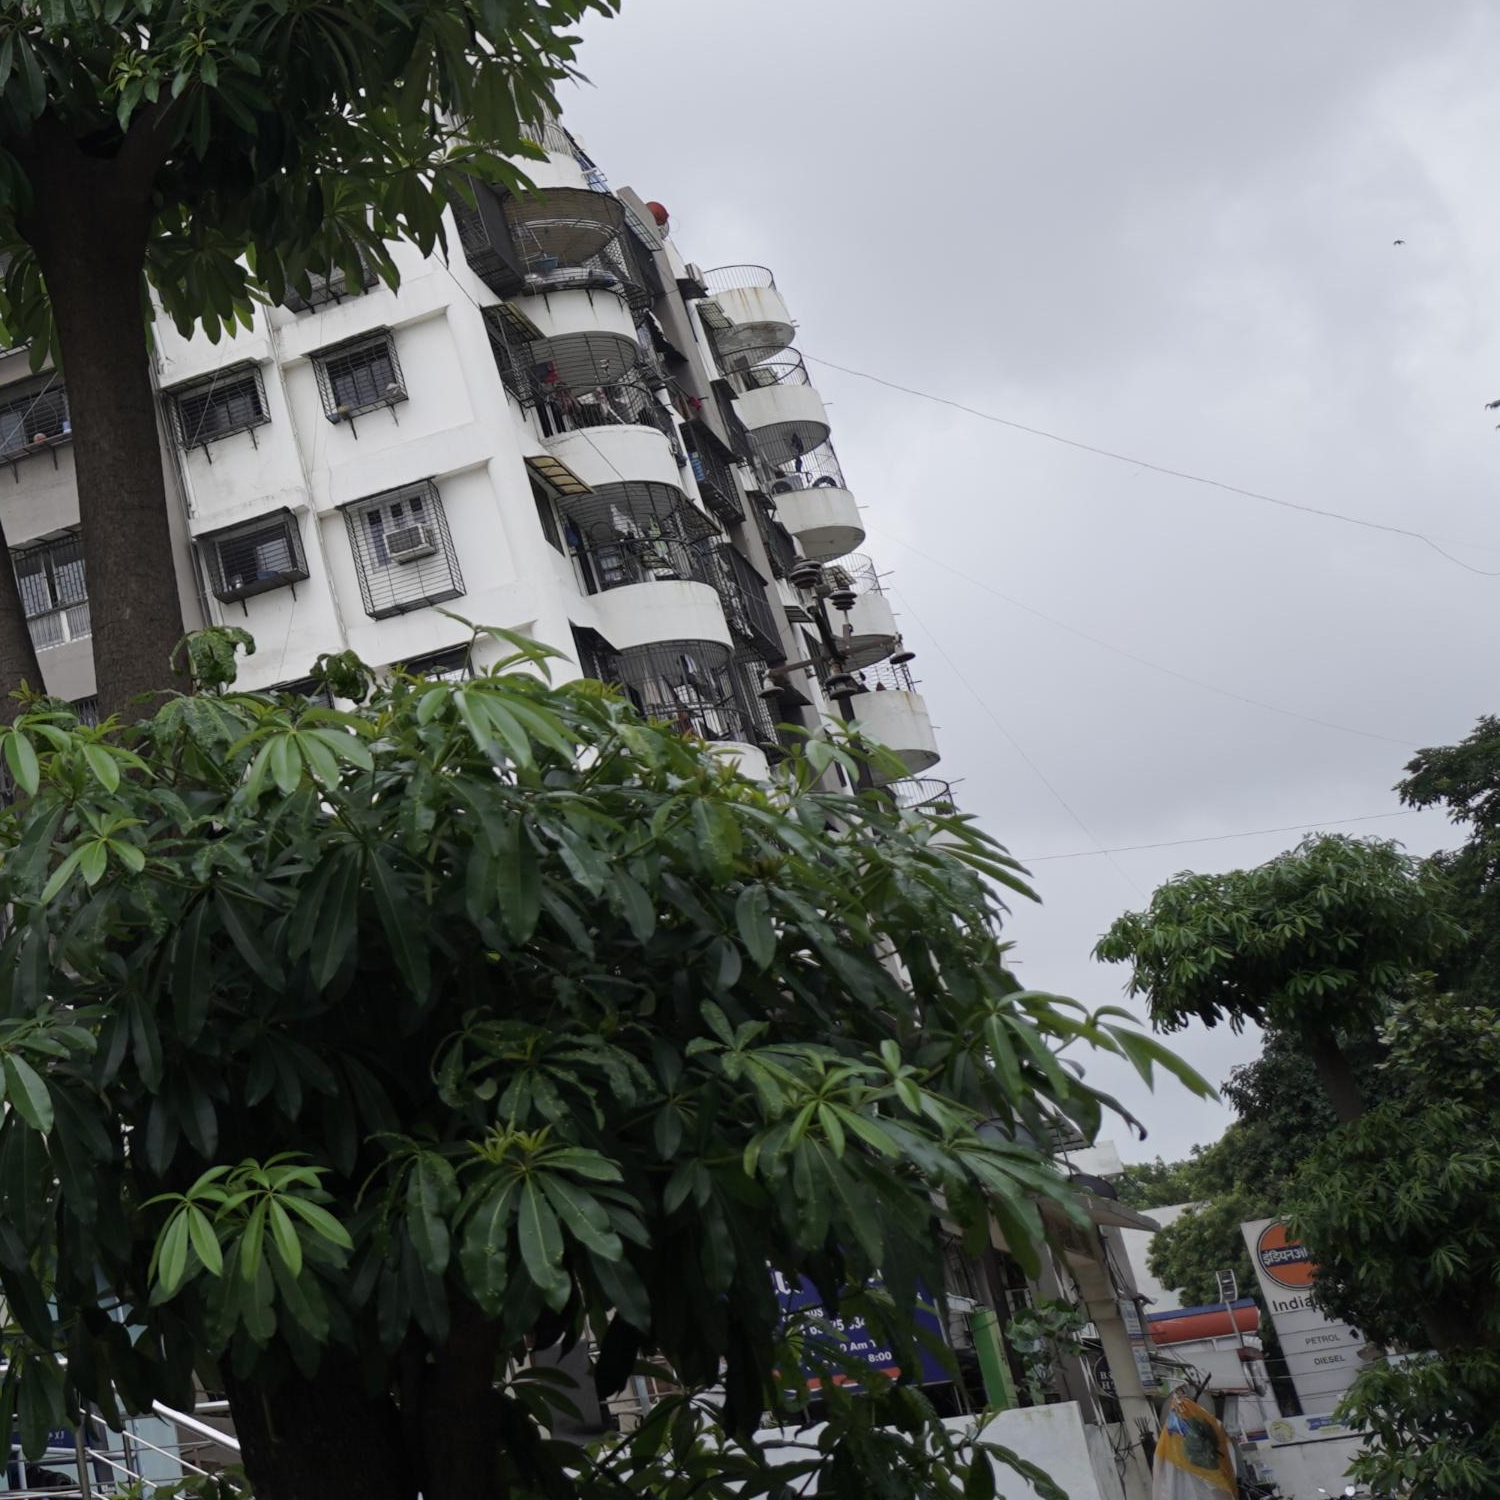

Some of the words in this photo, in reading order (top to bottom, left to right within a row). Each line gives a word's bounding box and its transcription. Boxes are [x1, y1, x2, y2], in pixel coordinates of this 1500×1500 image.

[1305, 1333, 1341, 1346] PETROL
[868, 1351, 892, 1362] 8:00
[1313, 1354, 1346, 1366] DIESEL
